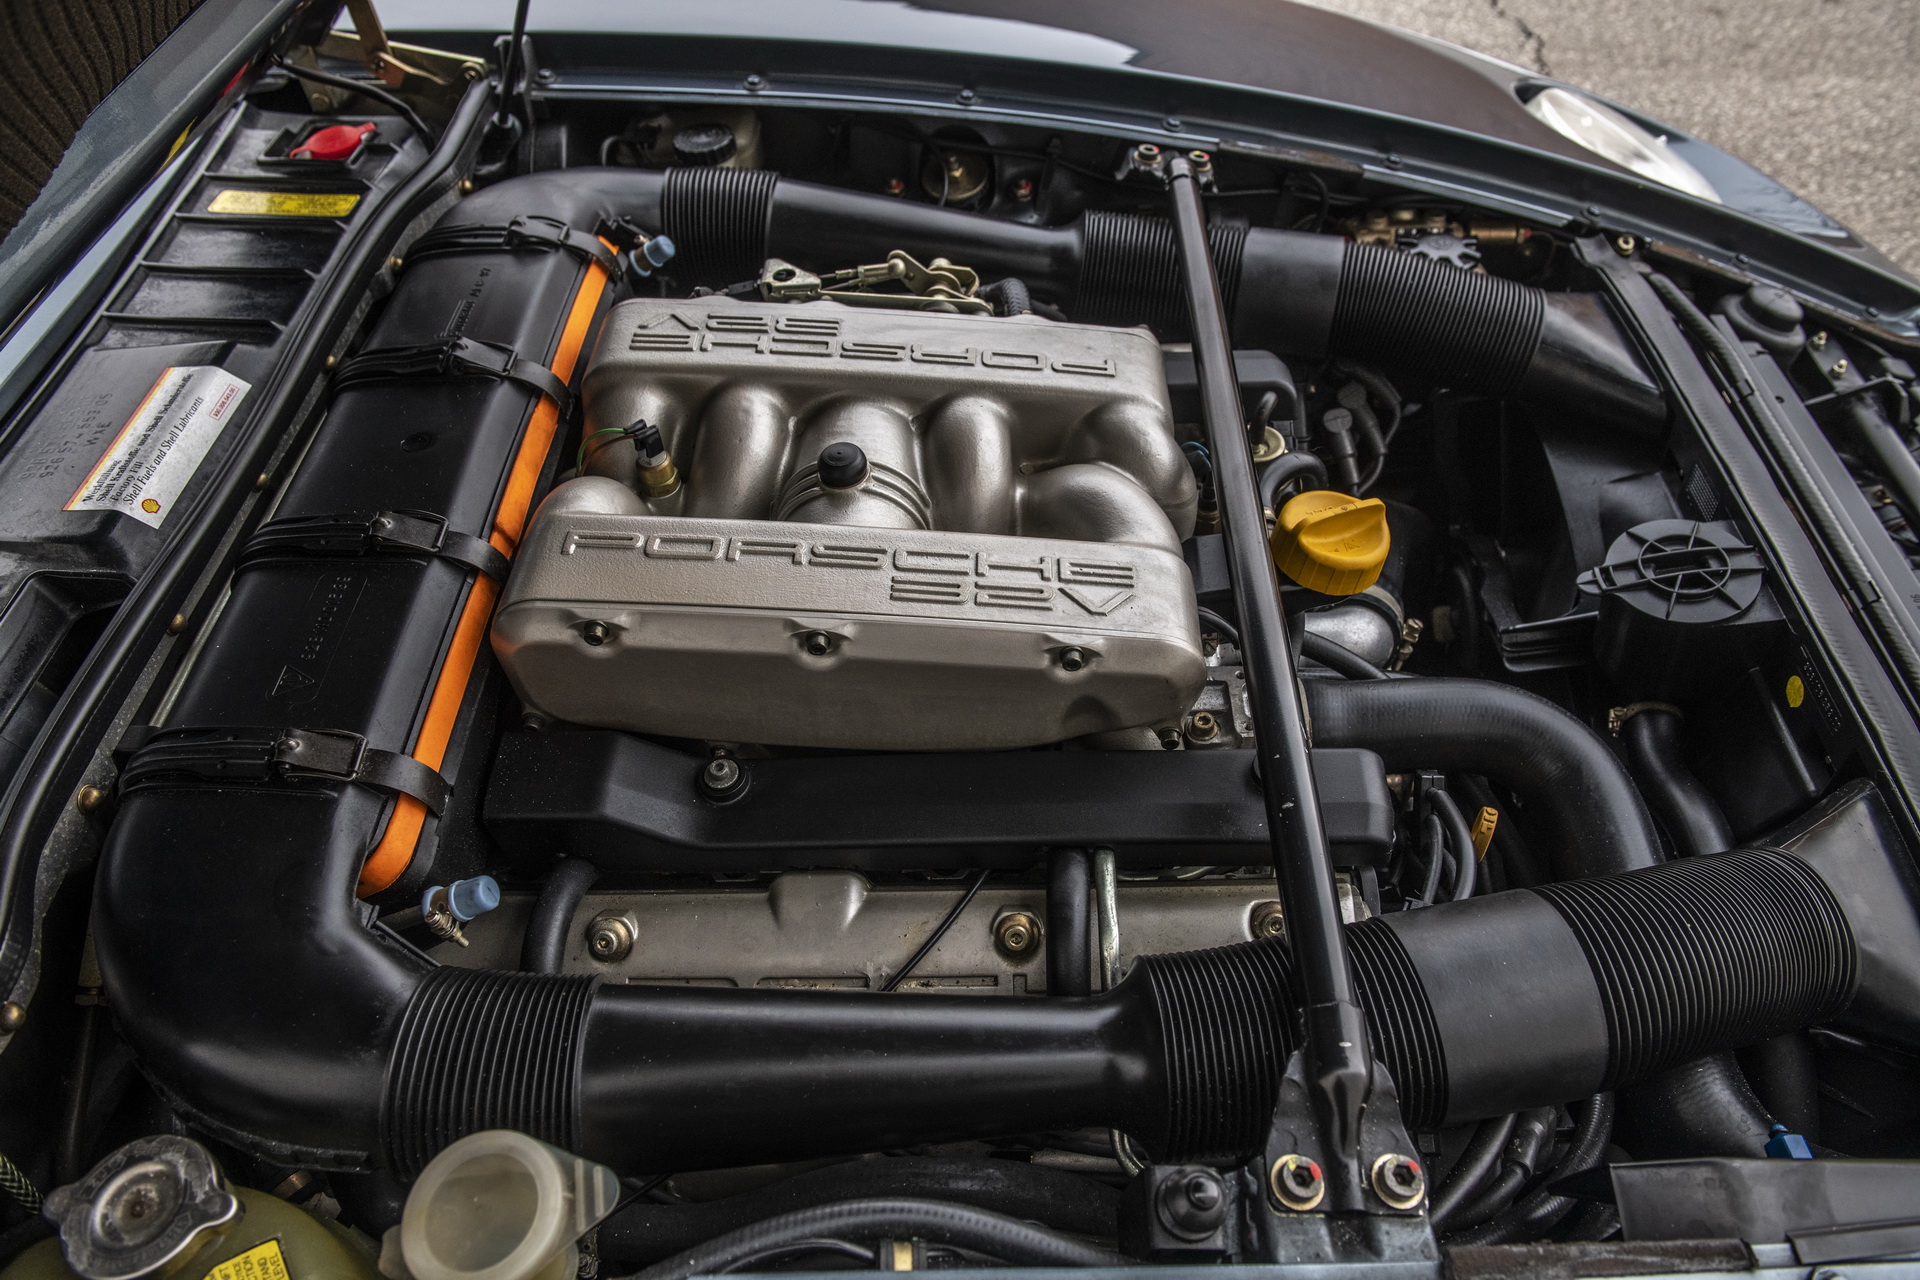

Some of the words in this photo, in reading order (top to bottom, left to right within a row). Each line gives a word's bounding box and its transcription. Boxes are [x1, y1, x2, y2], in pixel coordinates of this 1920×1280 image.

[629, 331, 1118, 378] PORSCHE
[123, 480, 143, 506] Shell
[137, 464, 157, 484] Fuels
[154, 448, 167, 465] and
[161, 431, 179, 452] Shell
[174, 396, 205, 433] Lubricants
[96, 481, 116, 502] Shell
[110, 473, 136, 502] Factory
[132, 461, 145, 476] Fill
[562, 529, 1136, 588] PORSCHE
[890, 575, 1136, 618] 32V
